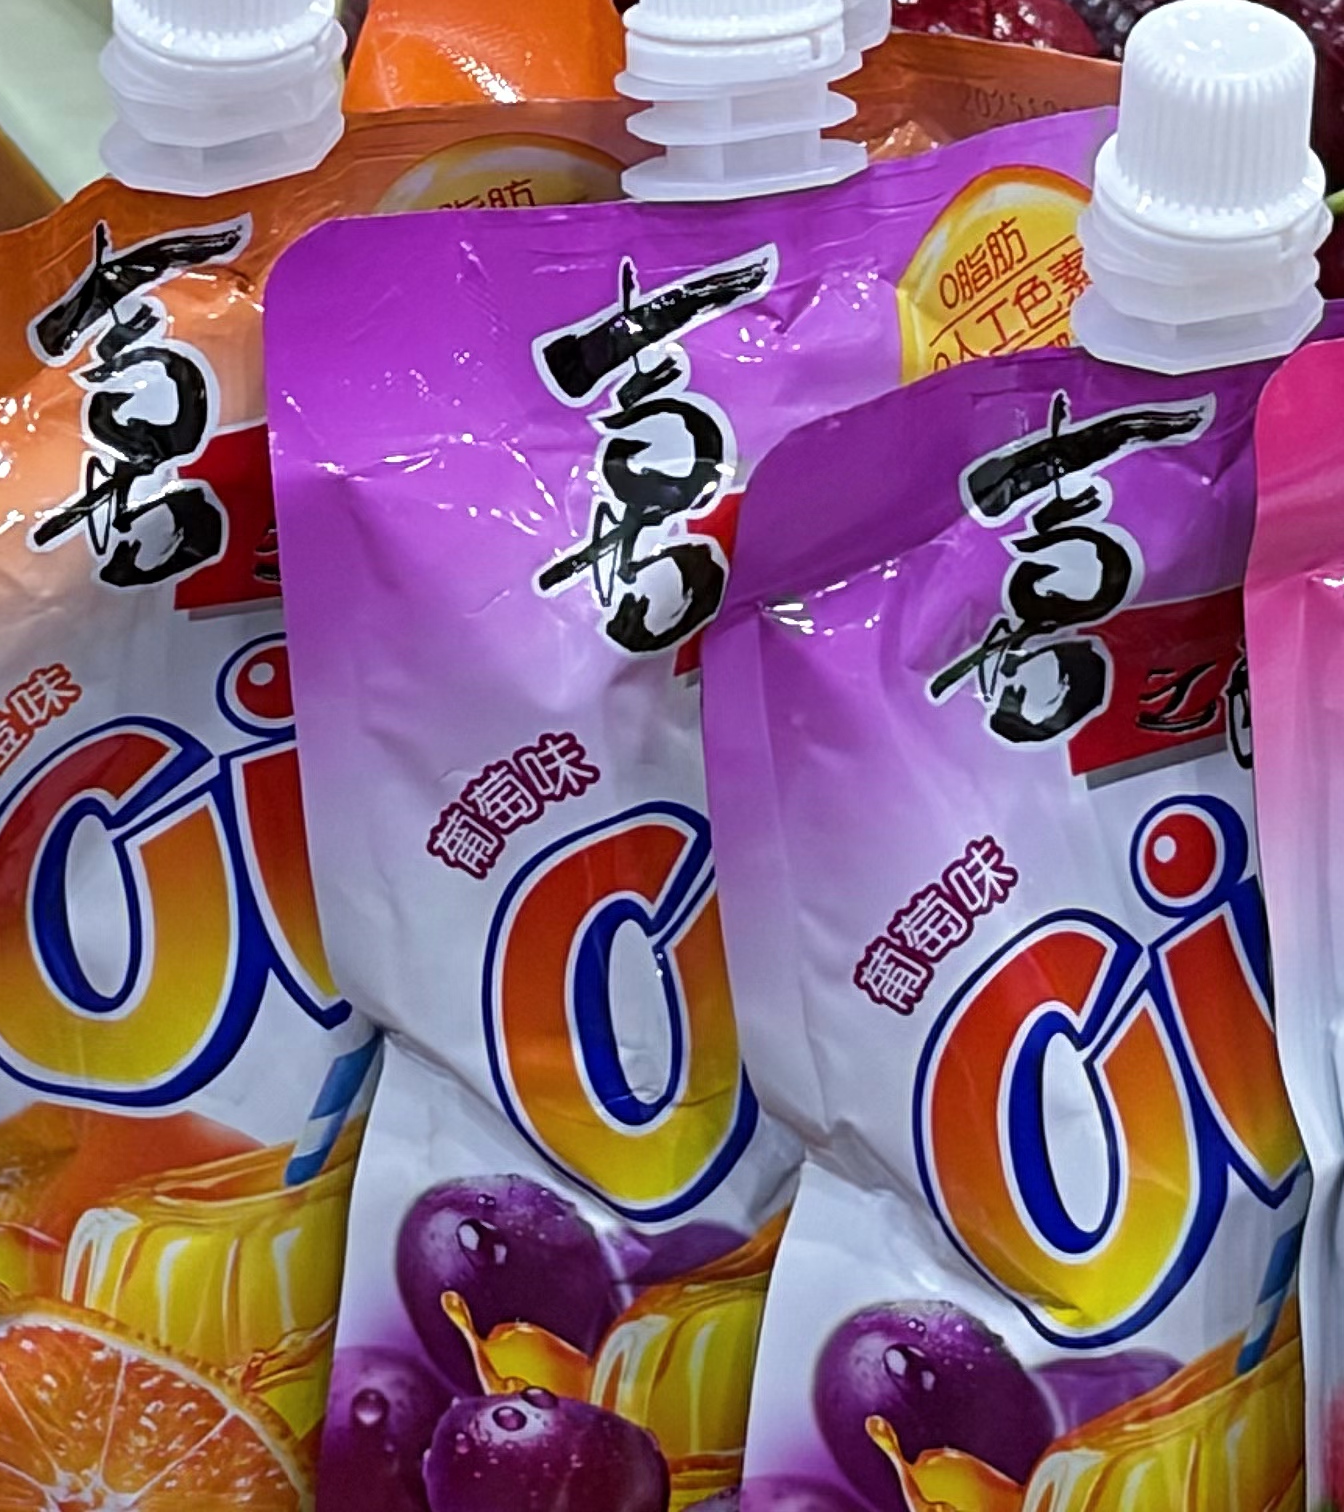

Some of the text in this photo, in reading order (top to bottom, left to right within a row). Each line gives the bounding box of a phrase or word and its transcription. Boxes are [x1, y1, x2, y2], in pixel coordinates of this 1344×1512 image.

[425, 732, 600, 880] 葡萄味
[854, 835, 1019, 1016] 葡萄味
